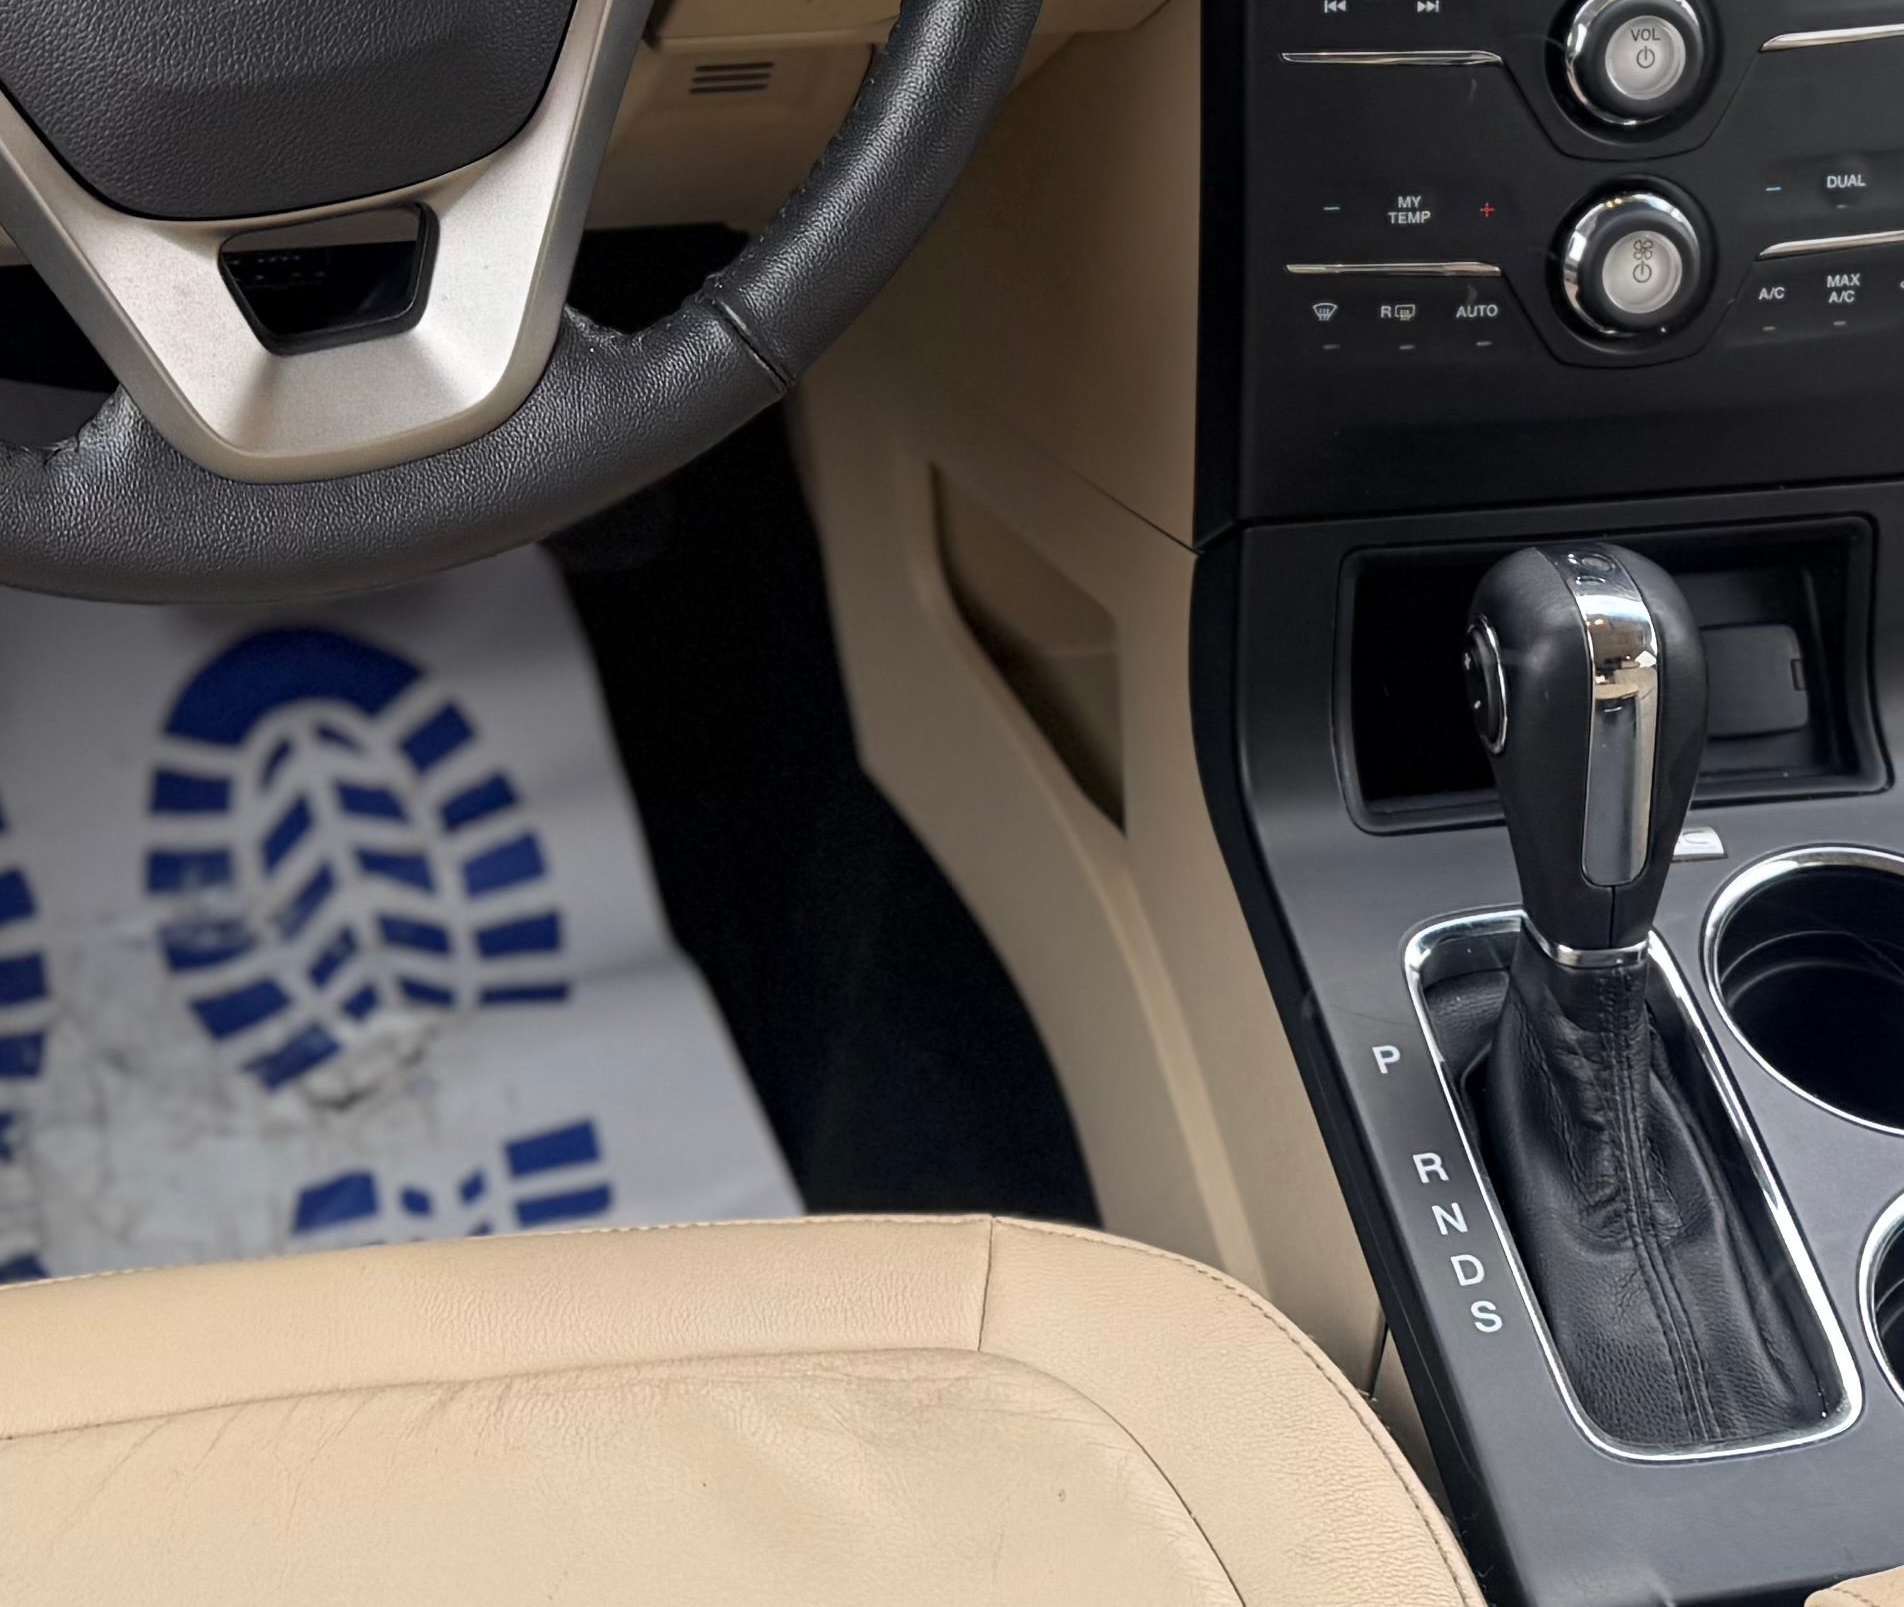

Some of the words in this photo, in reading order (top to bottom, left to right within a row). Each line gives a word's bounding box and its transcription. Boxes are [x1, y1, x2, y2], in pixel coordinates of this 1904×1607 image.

[1631, 28, 1661, 42] VOL
[1826, 174, 1866, 189] DUAL
[1397, 196, 1422, 208] MY
[1388, 210, 1431, 224] TEMP
[1826, 274, 1861, 288] MAX
[1758, 287, 1785, 301] A/C
[1828, 290, 1856, 304] A/C
[1456, 305, 1498, 319] AUTO
[1372, 1045, 1401, 1074] P
[1412, 1152, 1449, 1184] R
[1431, 1203, 1468, 1236] N
[1450, 1255, 1485, 1285] D
[1470, 1299, 1503, 1333] S
